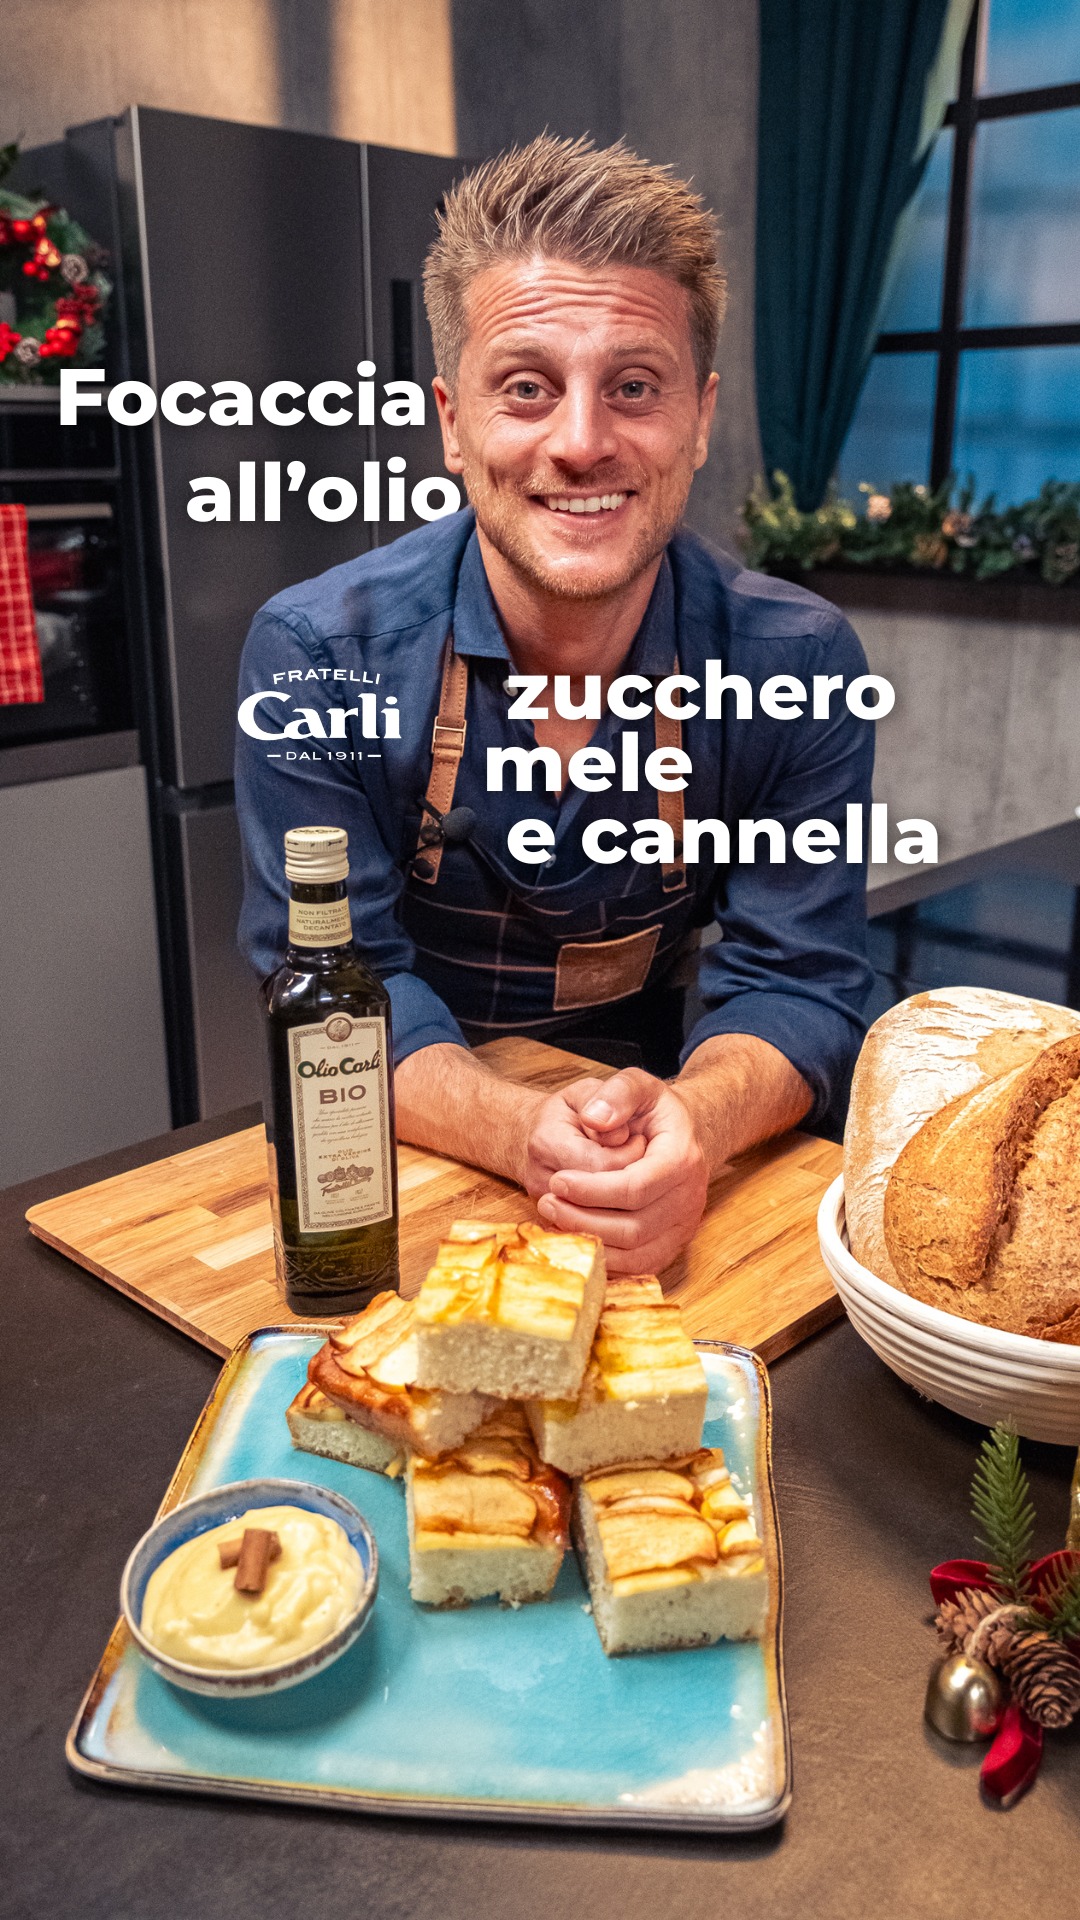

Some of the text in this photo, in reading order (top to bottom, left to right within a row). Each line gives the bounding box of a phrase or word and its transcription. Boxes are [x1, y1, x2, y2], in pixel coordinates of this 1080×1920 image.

[316, 905, 348, 916] FILTRATO
[303, 921, 347, 931] DECANTATO
[298, 1050, 381, 1078] Olio Carli
[319, 1084, 367, 1105] BIO
